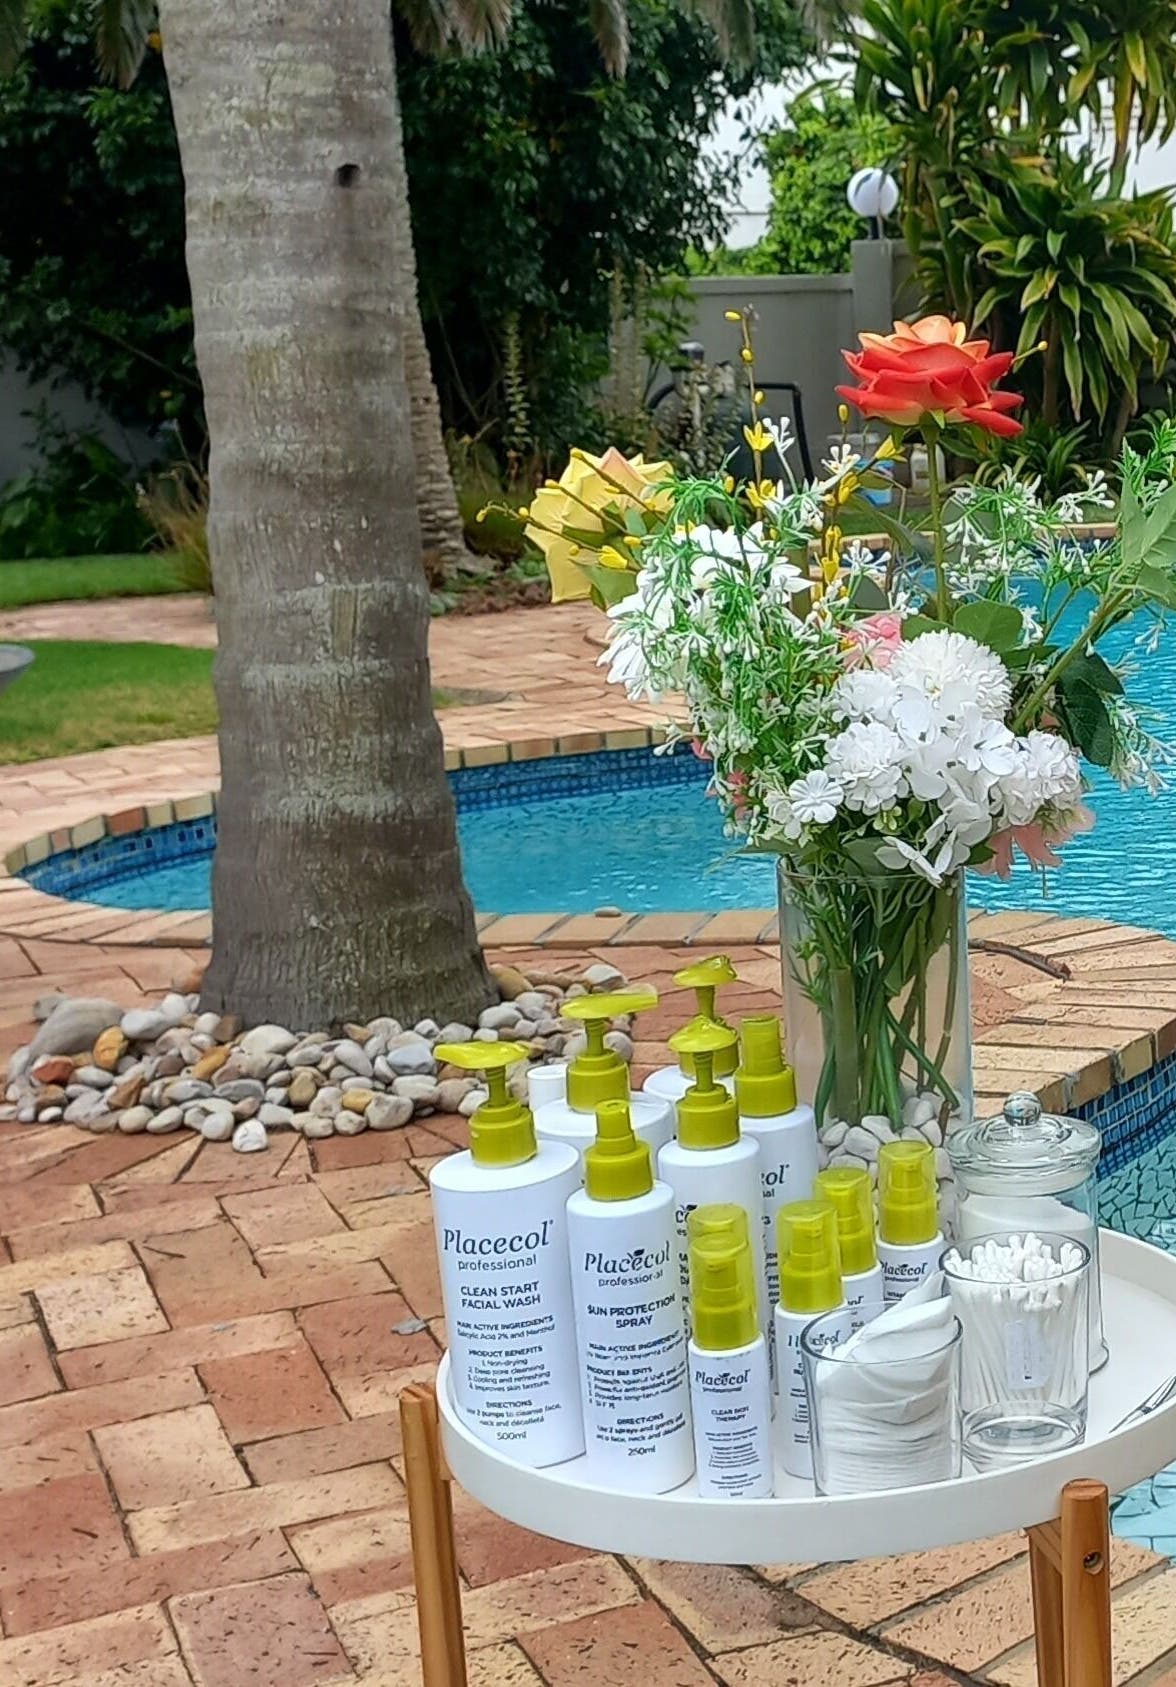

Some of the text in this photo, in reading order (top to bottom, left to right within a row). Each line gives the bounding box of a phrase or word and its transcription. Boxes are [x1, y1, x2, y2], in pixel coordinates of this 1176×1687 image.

[444, 1219, 552, 1255] Placecol
[458, 1254, 537, 1271] professional
[585, 1240, 670, 1274] Placecol
[598, 1269, 663, 1287] professional
[460, 1281, 540, 1297] CLEAN START
[461, 1294, 541, 1310] FACIAL WASH
[587, 1292, 676, 1317] SUN PROTECTION
[474, 1323, 499, 1331] ACTIVE
[616, 1315, 653, 1329] SPRAY
[468, 1345, 543, 1357] PRODUCT BENEFITS
[486, 1400, 533, 1409] DIRECTIONS
[497, 1431, 527, 1441] 500ml
[628, 1445, 656, 1457] 250ml
